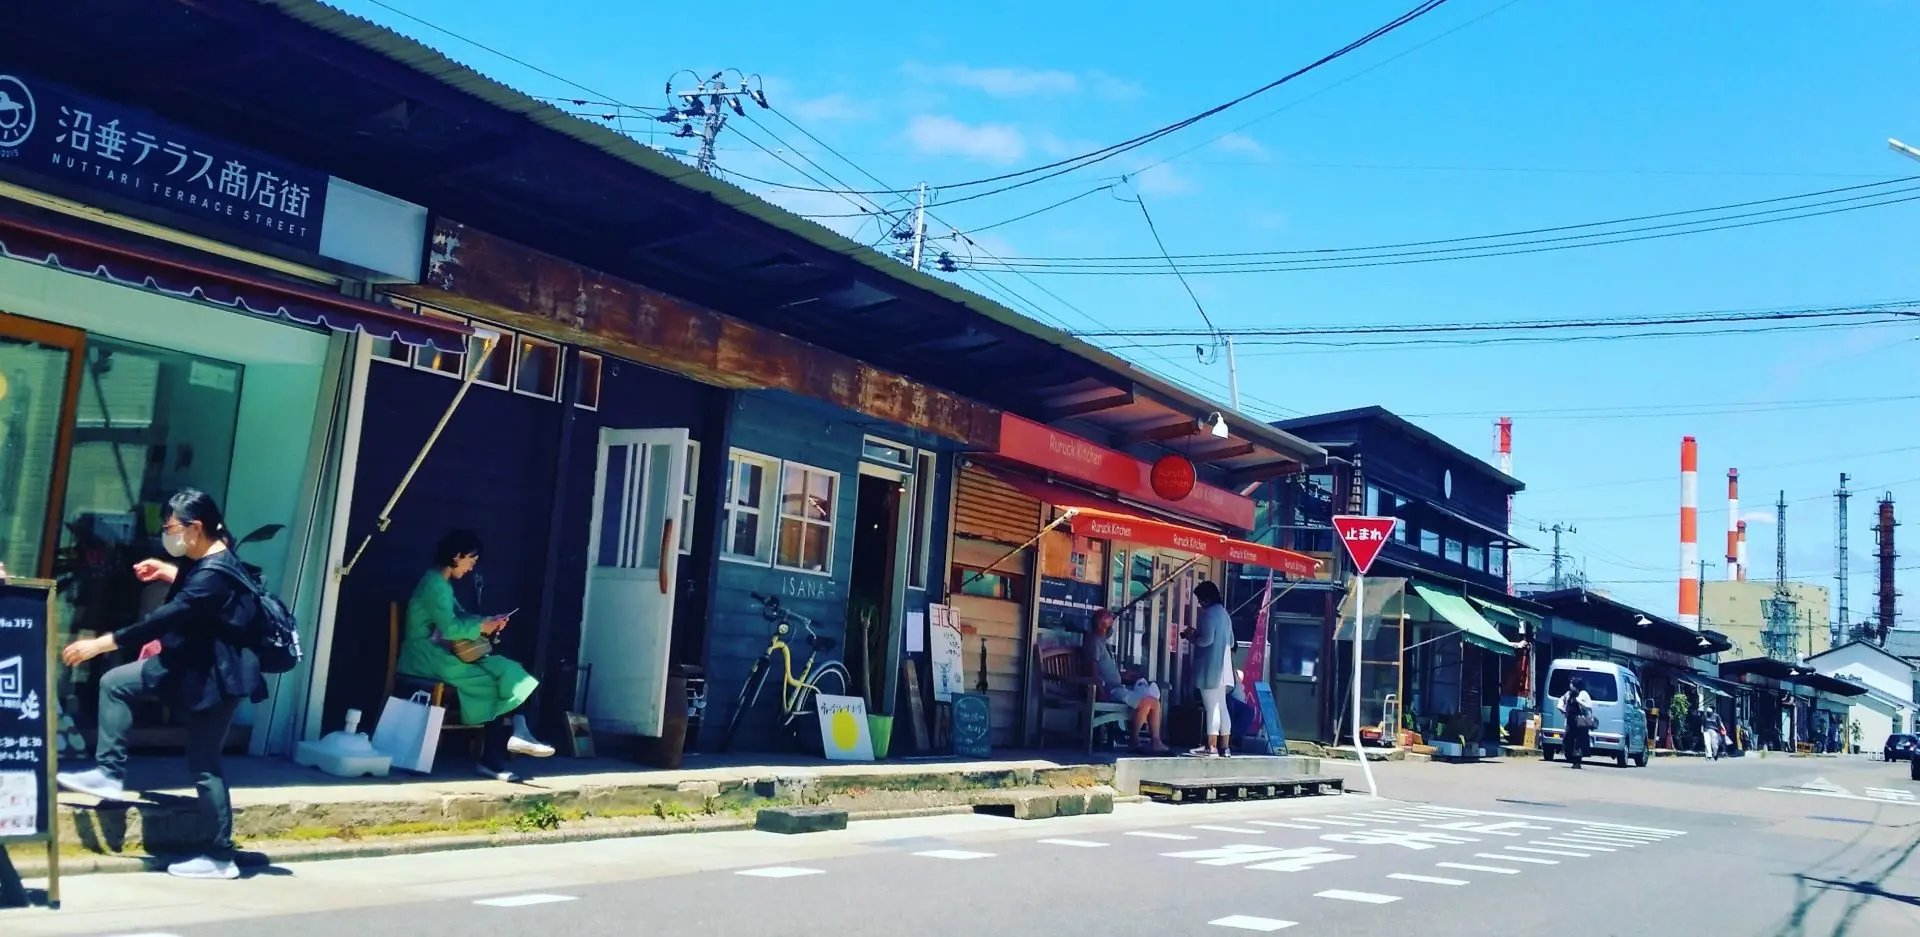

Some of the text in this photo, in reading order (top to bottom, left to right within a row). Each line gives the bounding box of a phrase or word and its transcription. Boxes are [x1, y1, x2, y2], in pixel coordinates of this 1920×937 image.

[55, 105, 311, 218] 沼垂テラス商店街
[51, 153, 307, 237] NUTTARI TERRACE STREET
[1091, 520, 1132, 537] Ruruck Kitchen
[1344, 527, 1384, 541] 止まれ
[1173, 534, 1207, 551] Ruruck Kitchen
[782, 576, 825, 598] ISANA
